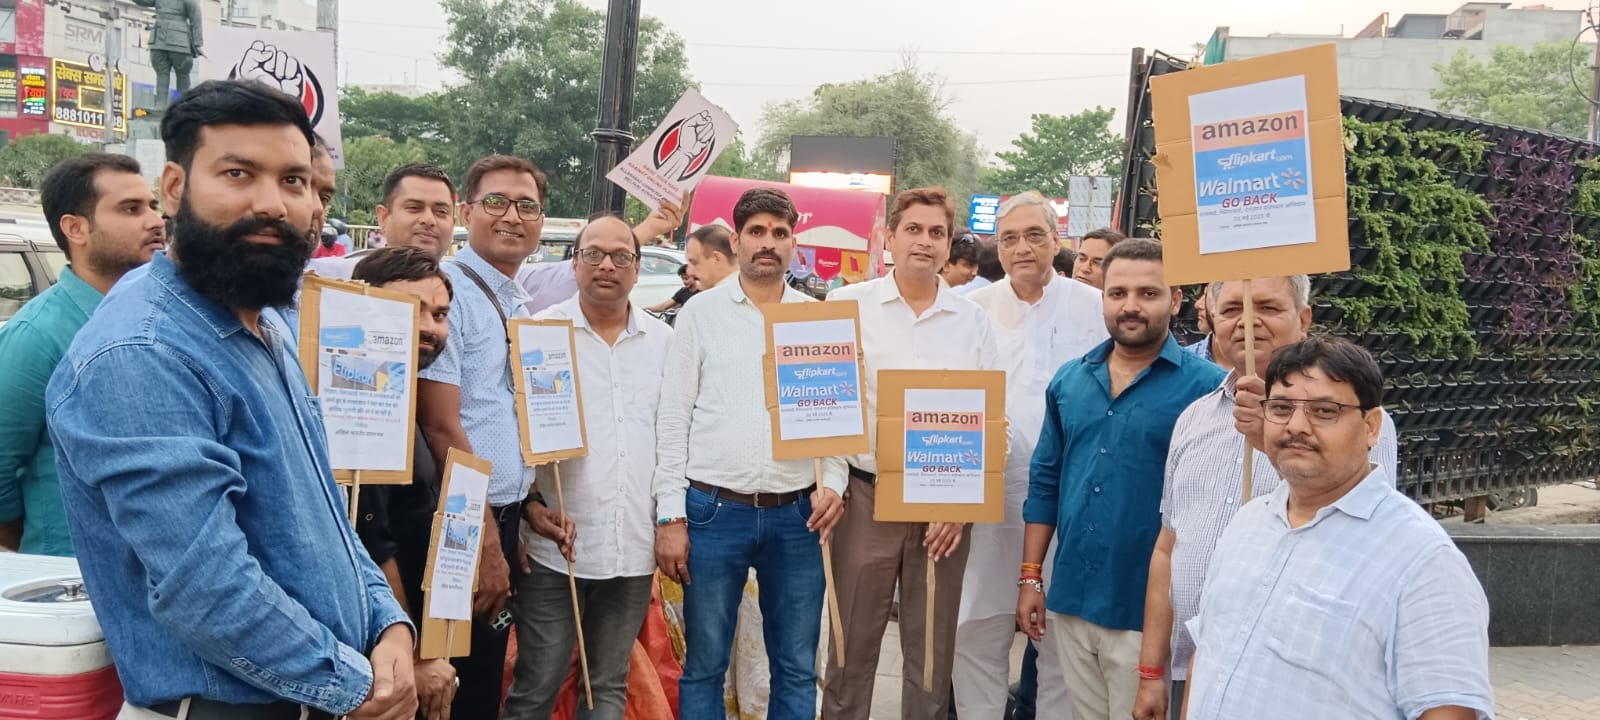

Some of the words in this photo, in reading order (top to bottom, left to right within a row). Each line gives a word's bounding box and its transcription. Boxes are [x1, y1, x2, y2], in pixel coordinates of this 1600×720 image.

[64, 24, 102, 43] SRM
[56, 63, 82, 82] सेक्स
[56, 107, 122, 127] 88810118
[1202, 114, 1298, 140] amazon
[1199, 173, 1281, 198] Walmart
[1222, 197, 1240, 209] GO
[1243, 193, 1278, 207] BACK
[783, 345, 850, 357] amazon
[781, 384, 839, 398] Walmart
[797, 399, 811, 407] GO
[813, 398, 838, 406] BACK
[912, 411, 979, 425] amazon
[907, 450, 965, 463] Walmart
[922, 465, 936, 473] GO
[937, 465, 962, 473] BACK
